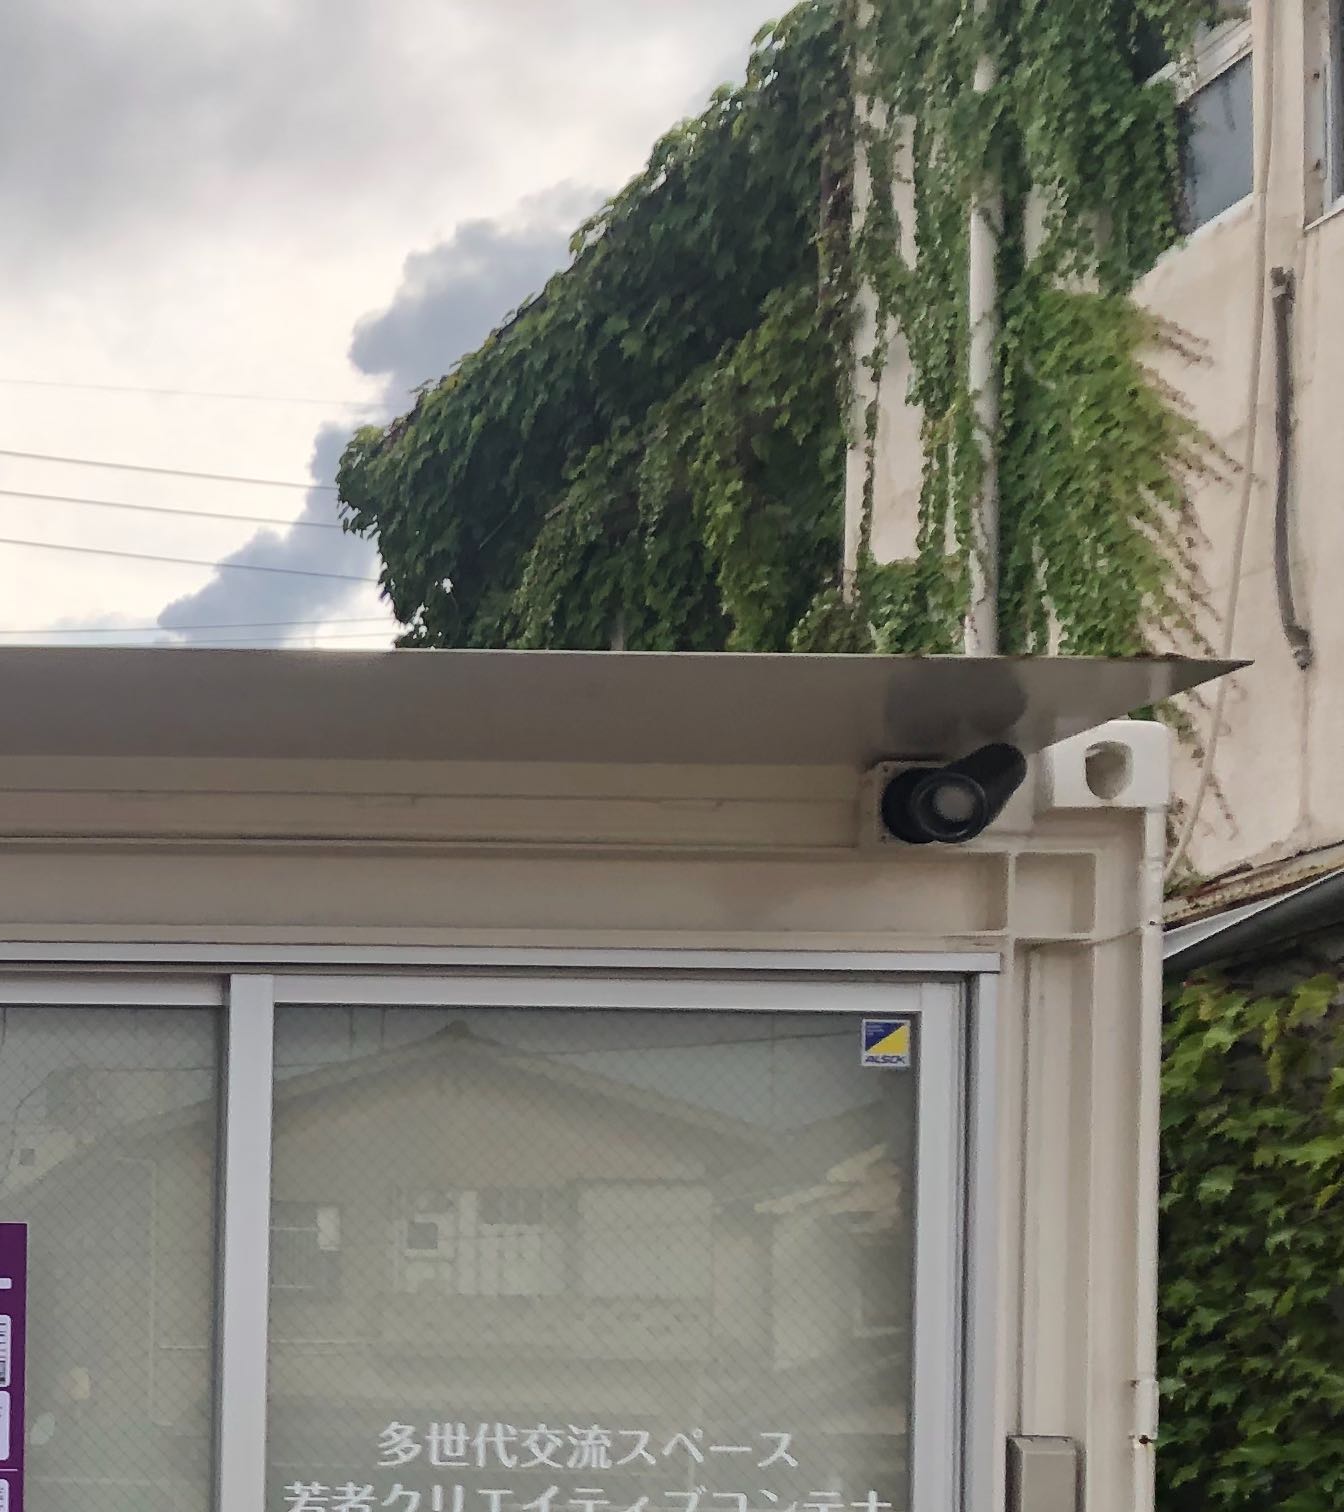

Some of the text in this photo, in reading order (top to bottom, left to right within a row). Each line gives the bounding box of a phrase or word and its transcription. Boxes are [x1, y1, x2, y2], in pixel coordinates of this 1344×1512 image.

[377, 1421, 799, 1470] 多世代交流スペース
